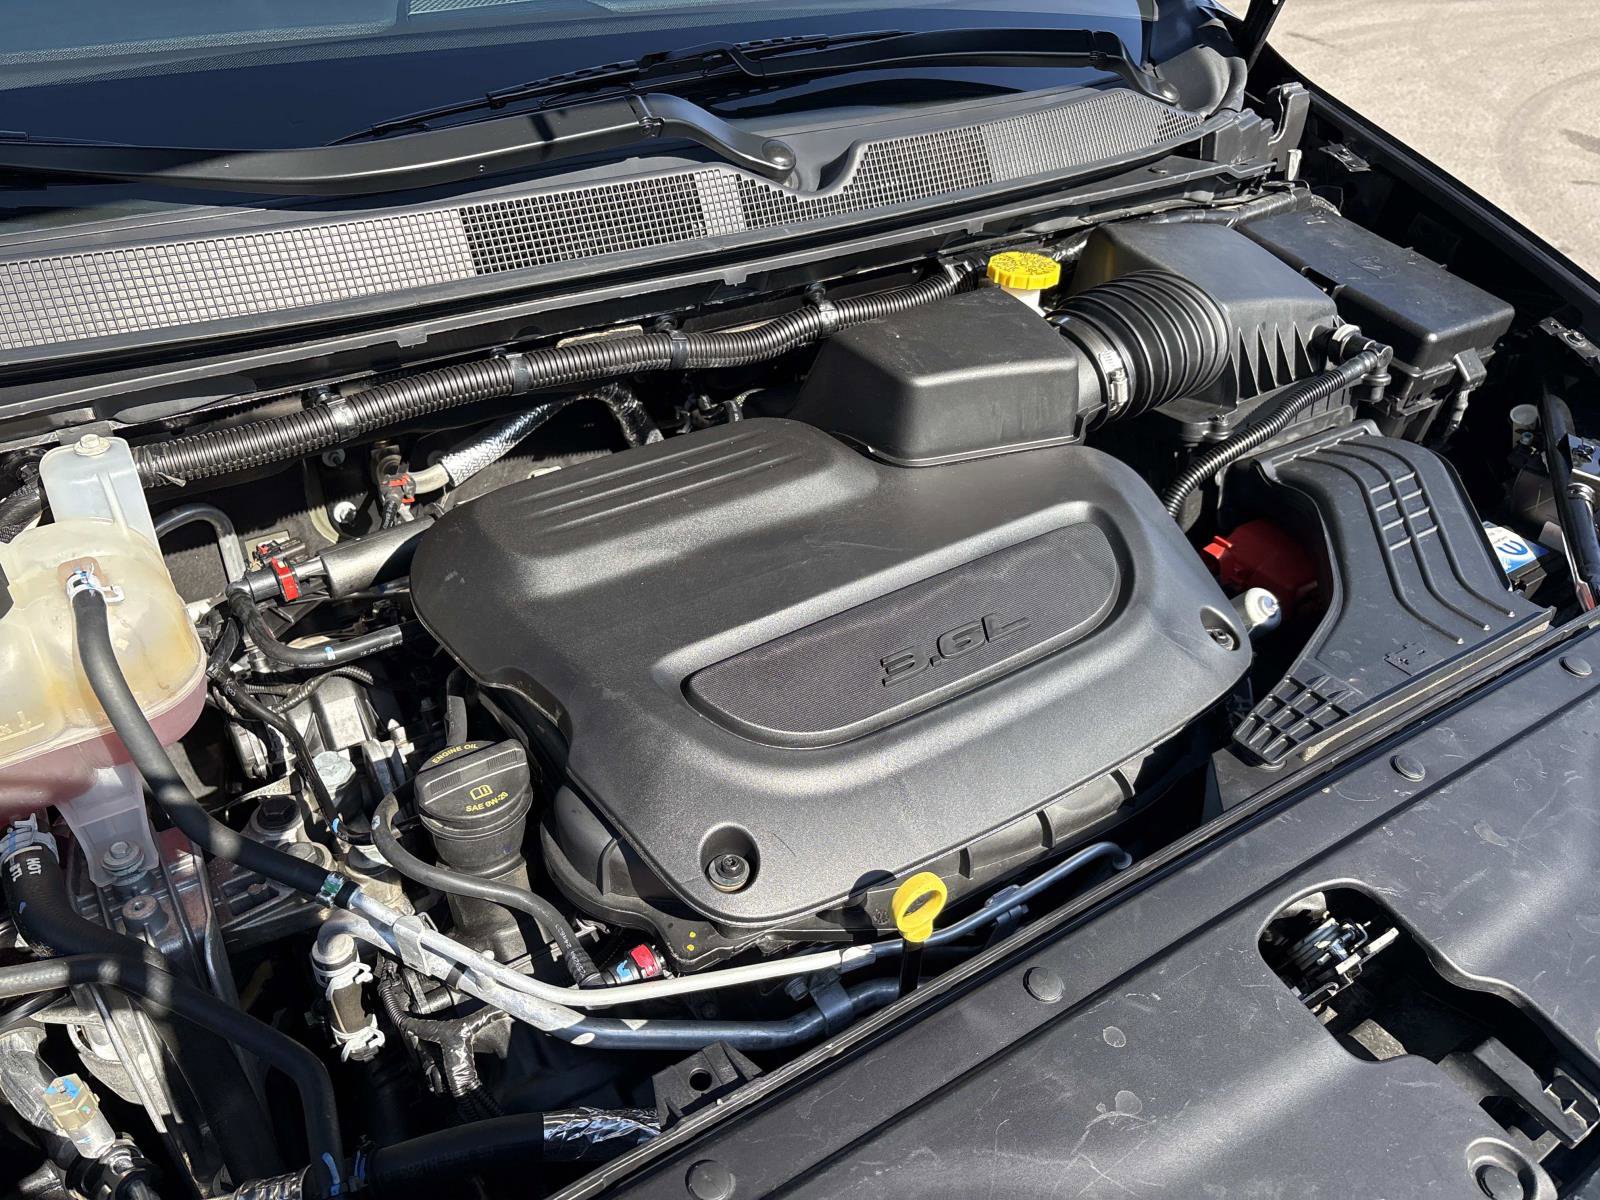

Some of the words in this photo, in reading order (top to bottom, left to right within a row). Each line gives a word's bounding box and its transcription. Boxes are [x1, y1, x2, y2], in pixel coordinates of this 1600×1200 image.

[880, 612, 1030, 687] 3.6L
[432, 745, 463, 764] ENGINE
[465, 803, 485, 812] SAE
[485, 791, 509, 807] 0W-20
[26, 857, 42, 875] HOT
